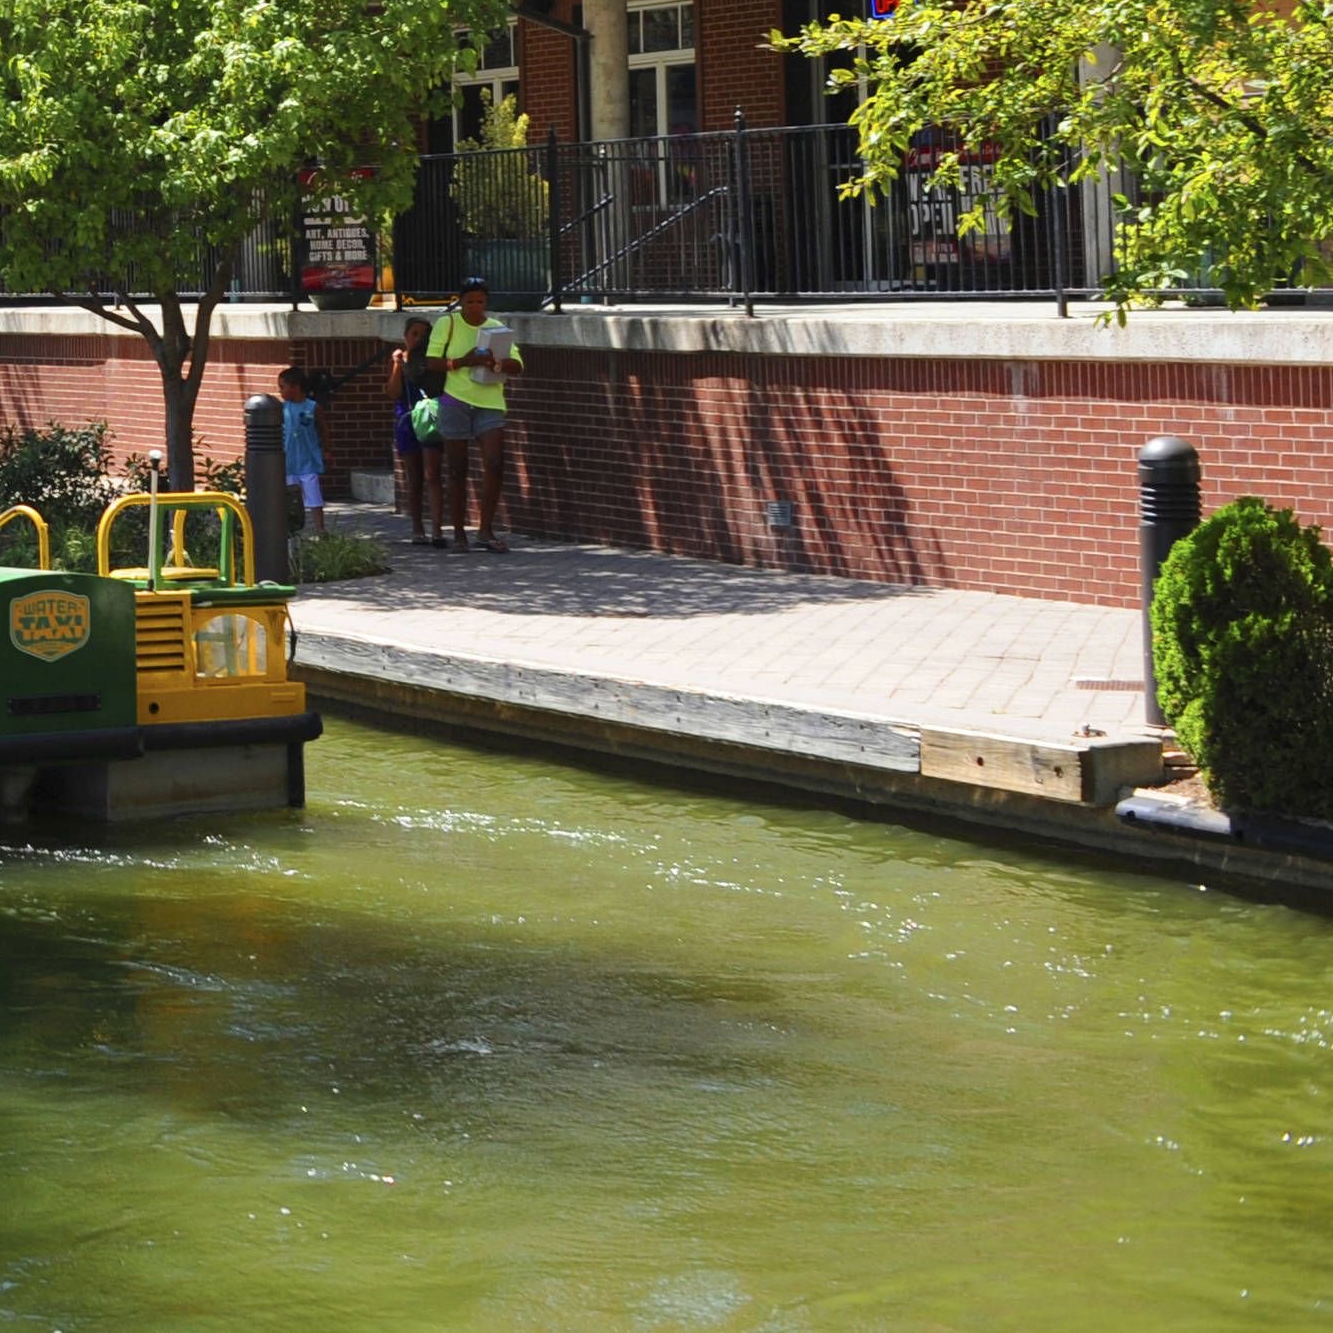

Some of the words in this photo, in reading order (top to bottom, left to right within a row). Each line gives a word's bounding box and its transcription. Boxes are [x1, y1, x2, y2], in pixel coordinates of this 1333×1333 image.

[310, 239, 334, 250] HOME
[309, 251, 333, 262] GIFTS
[335, 251, 342, 261] &
[344, 250, 368, 261] MORE
[24, 600, 78, 615] WATER
[19, 617, 84, 641] TAXI
